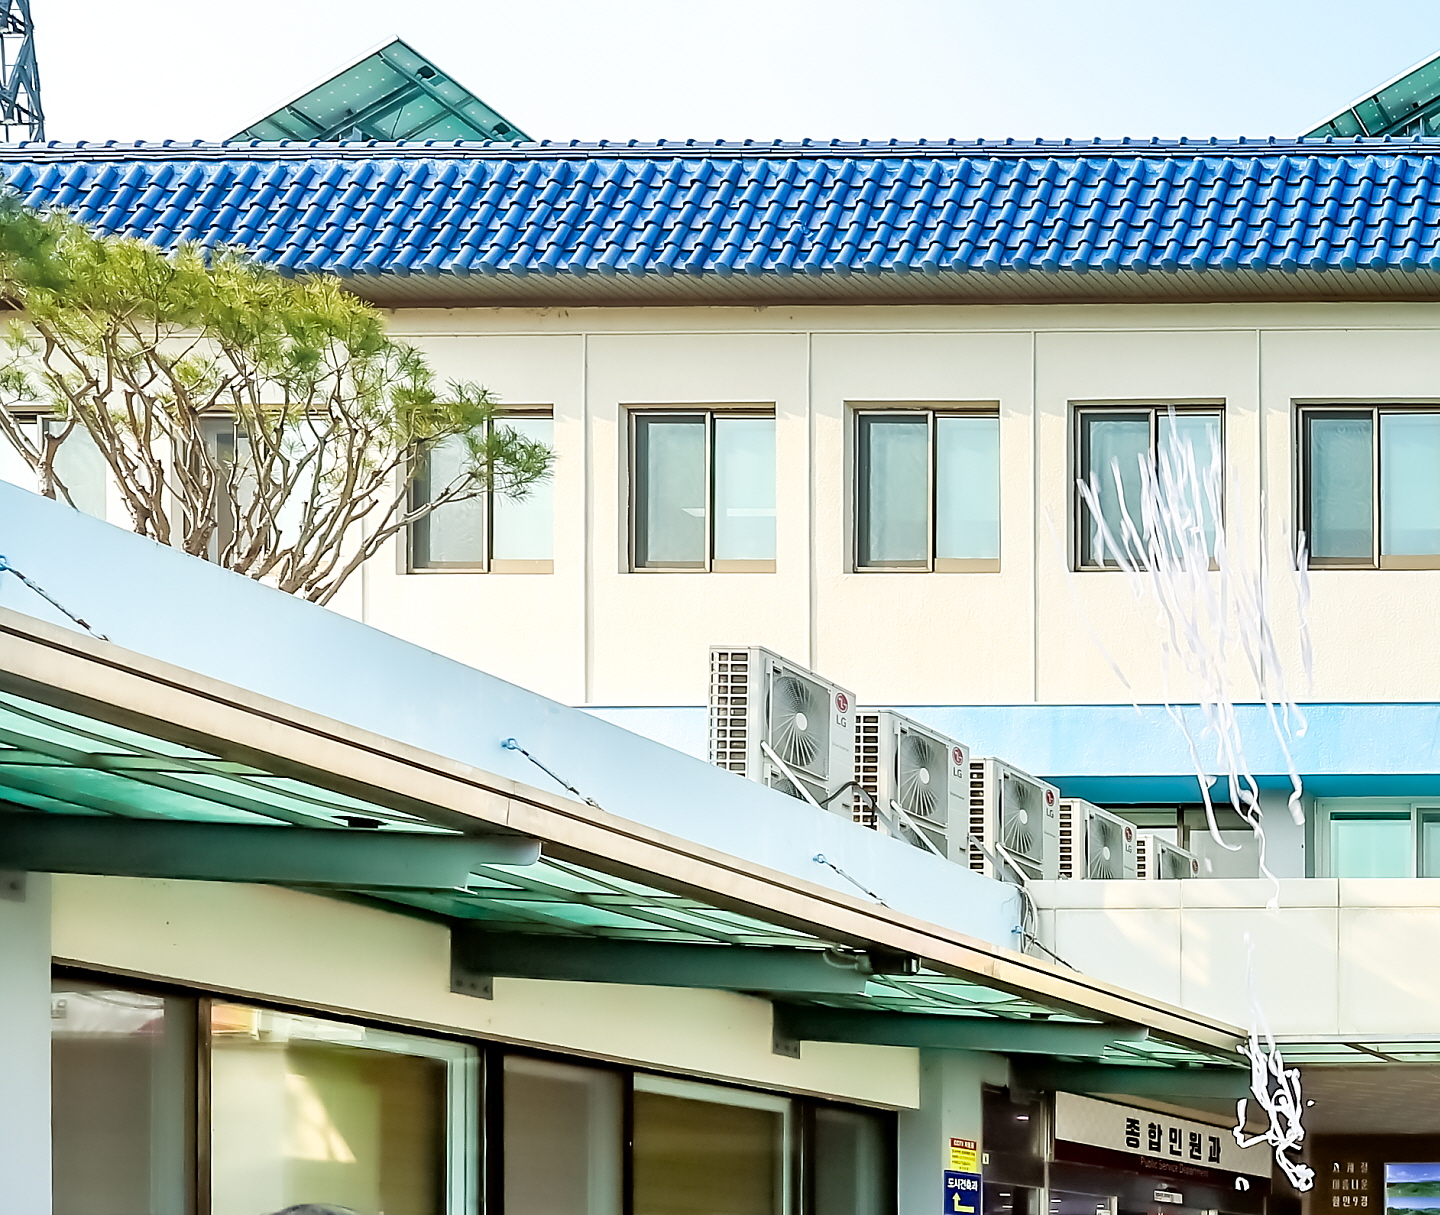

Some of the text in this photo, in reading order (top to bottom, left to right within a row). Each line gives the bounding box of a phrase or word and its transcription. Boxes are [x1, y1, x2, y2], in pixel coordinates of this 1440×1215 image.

[836, 714, 847, 728] LG
[953, 766, 963, 779] LG
[1046, 807, 1054, 819] LG
[1125, 1117, 1222, 1163] 종합민원과
